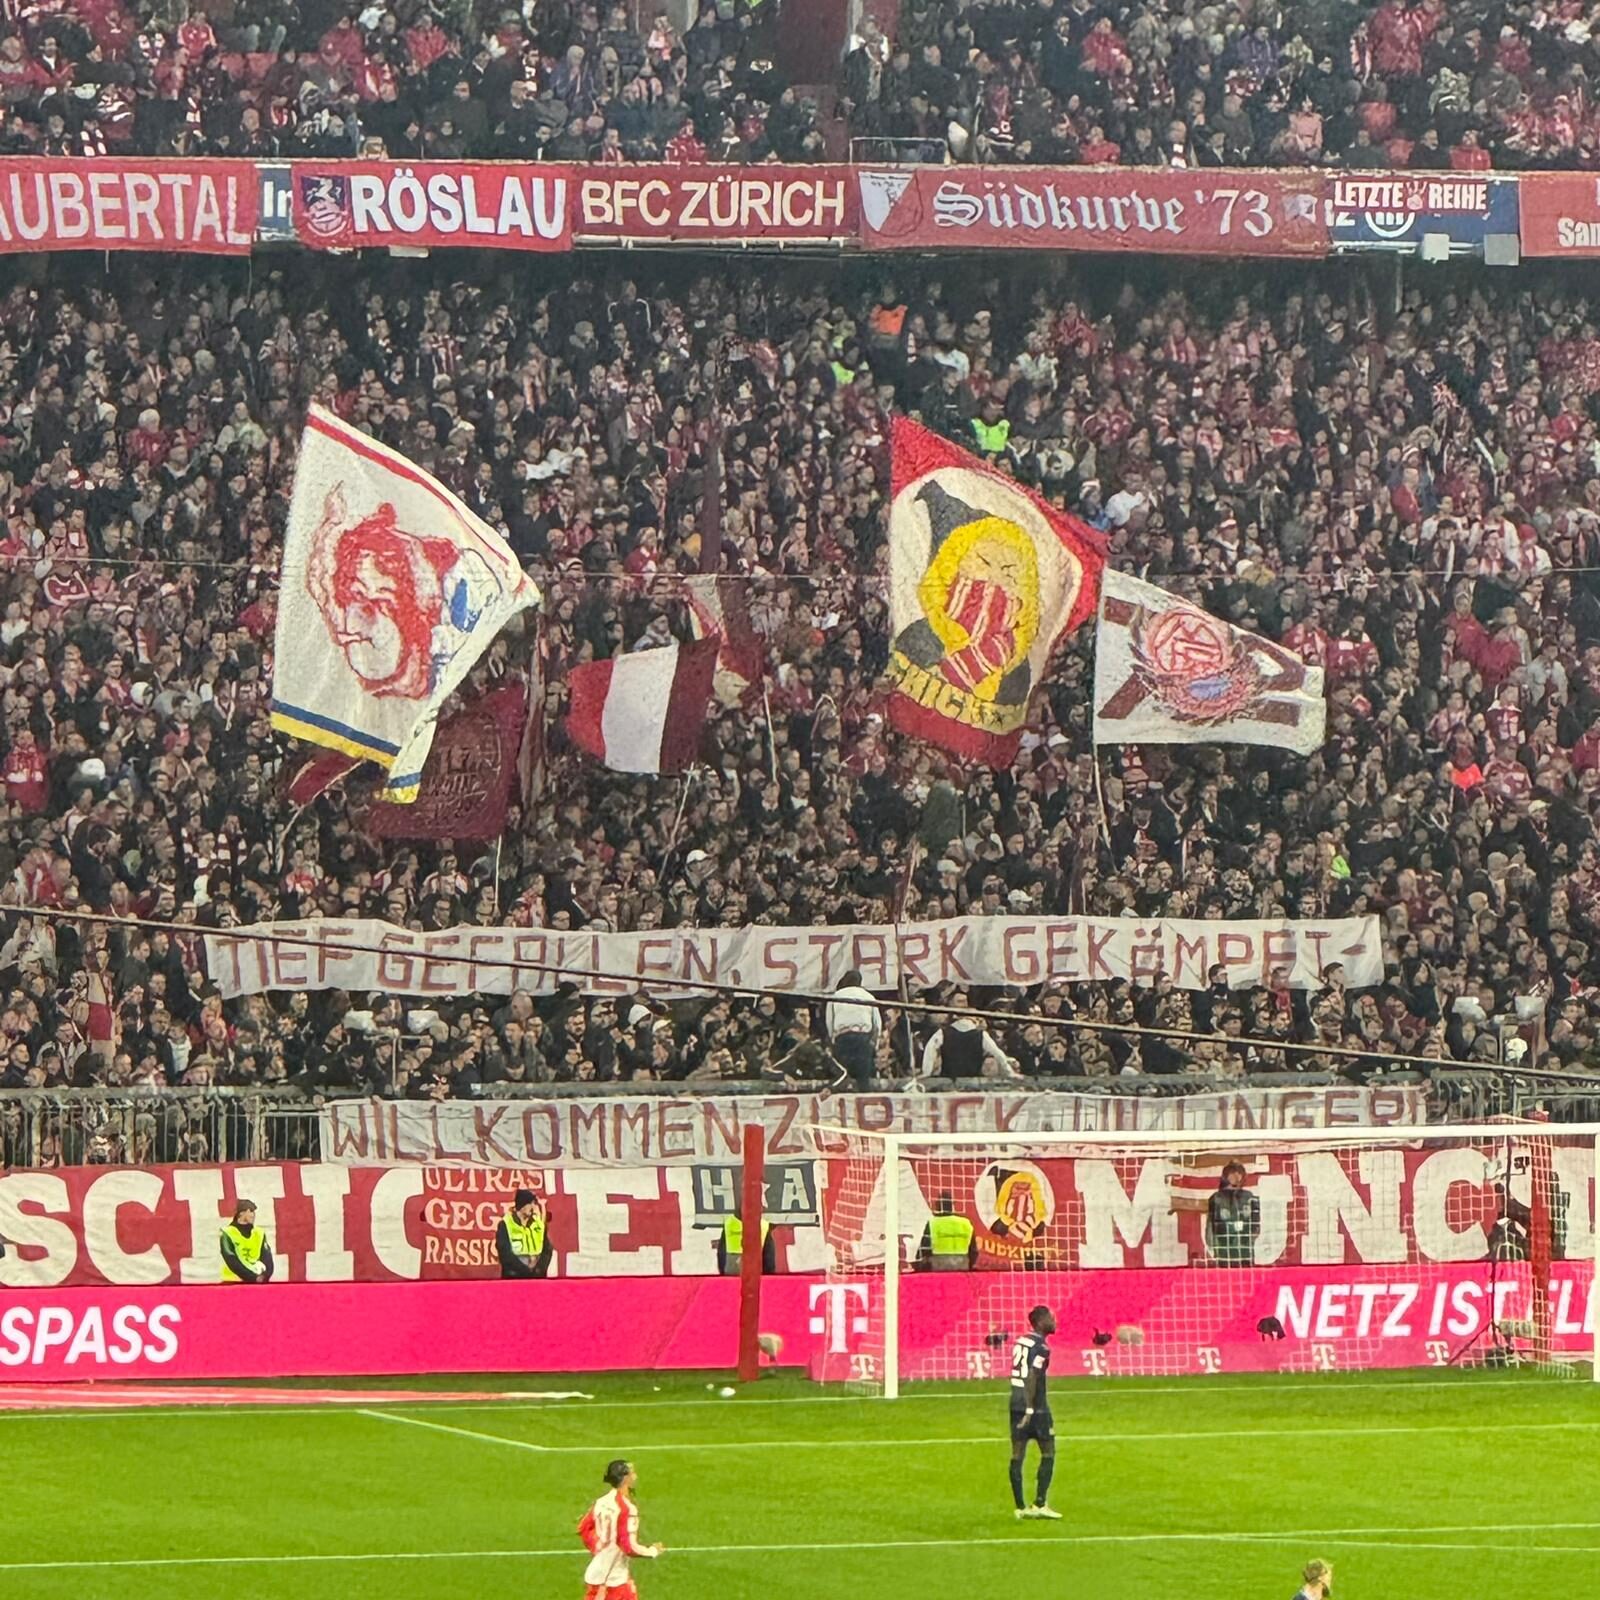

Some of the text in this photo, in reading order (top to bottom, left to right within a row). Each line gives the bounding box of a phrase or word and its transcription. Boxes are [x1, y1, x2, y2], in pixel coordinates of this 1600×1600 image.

[351, 168, 566, 240] RÖSLAU
[581, 174, 845, 226] BFC ZÜRICH
[933, 180, 1185, 234] Südkurve
[1334, 181, 1488, 211] LETZTE REIHE
[214, 928, 354, 993] TIEF
[763, 924, 970, 990] STARK
[330, 1101, 742, 1160] WILLKOMMEN
[425, 1168, 544, 1193] ULTRAS
[425, 1198, 547, 1231] GEG
[0, 1304, 181, 1366] SPASS
[1274, 1282, 1418, 1338] NETZ
[1428, 1281, 1519, 1337] IST
